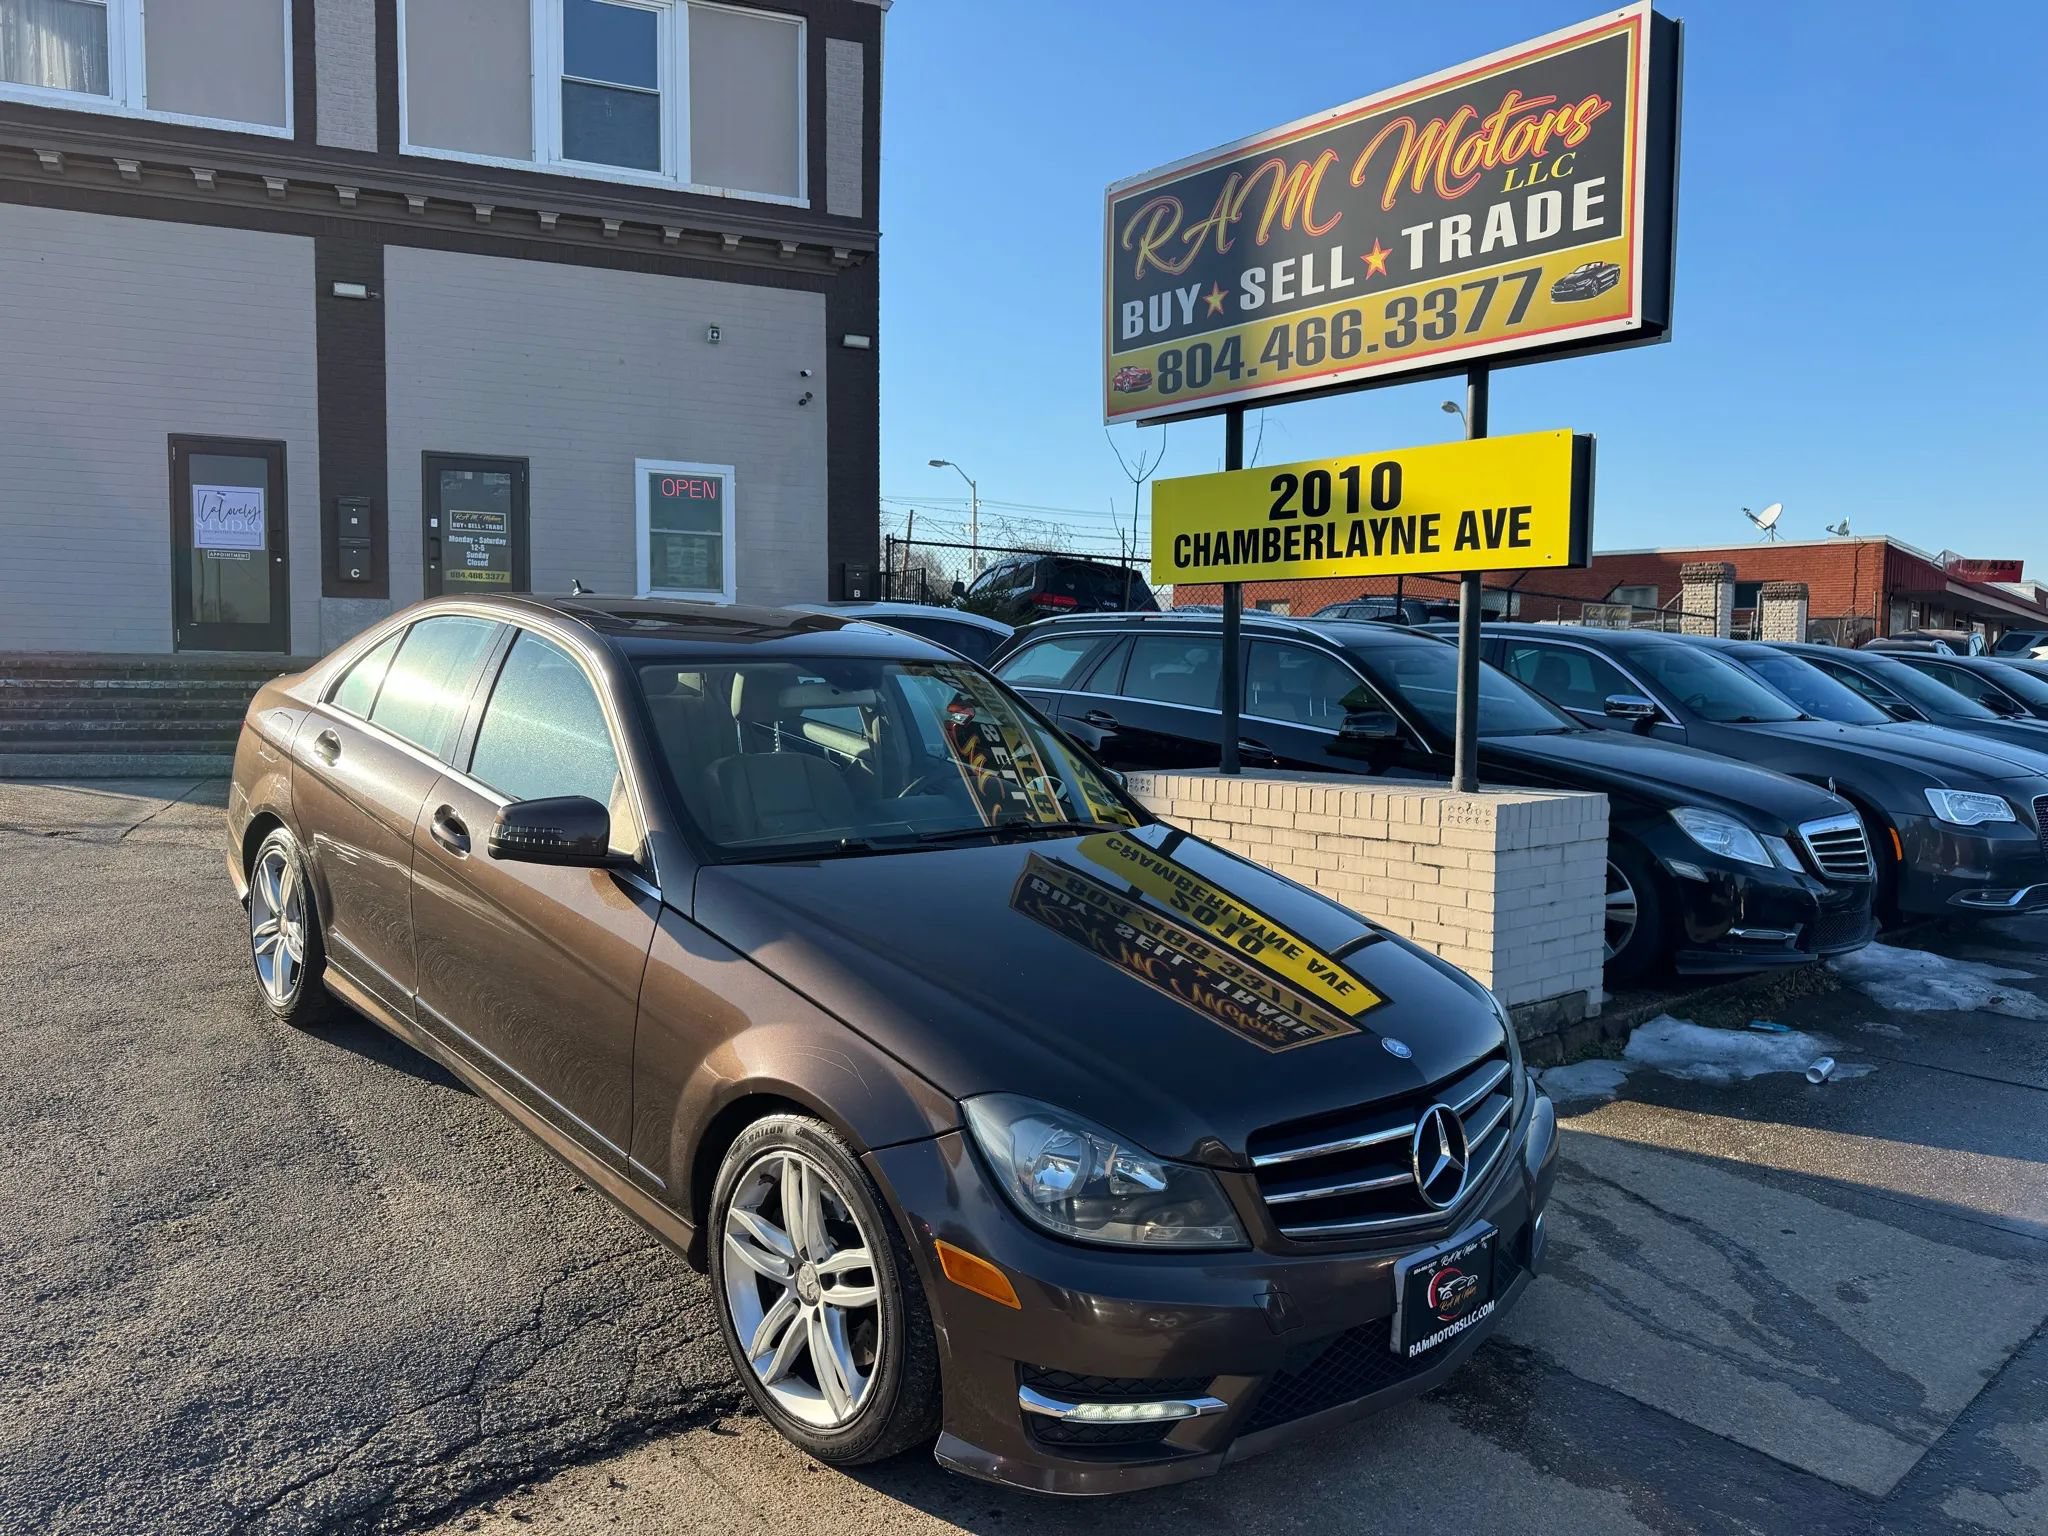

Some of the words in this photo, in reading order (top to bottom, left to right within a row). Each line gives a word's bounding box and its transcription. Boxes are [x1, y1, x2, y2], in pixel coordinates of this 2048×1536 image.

[1122, 148, 1342, 281] RAM
[1350, 89, 1612, 212] Motors
[1501, 152, 1577, 193] LLC
[1122, 283, 1202, 341] BUY
[1240, 245, 1355, 311] SELL
[1401, 176, 1606, 271] TRADE
[1157, 267, 1543, 395] 804.466.3377
[661, 478, 716, 499] OPEN
[1268, 460, 1403, 521] 2010
[448, 535, 474, 544] Monday
[479, 536, 507, 546] Saturday
[1173, 513, 1440, 569] CHAMBERLAYNE
[1454, 505, 1532, 552] AVE
[466, 551, 490, 560] Sunday
[467, 559, 489, 567] Closed
[351, 568, 360, 578] C
[853, 589, 861, 598] B
